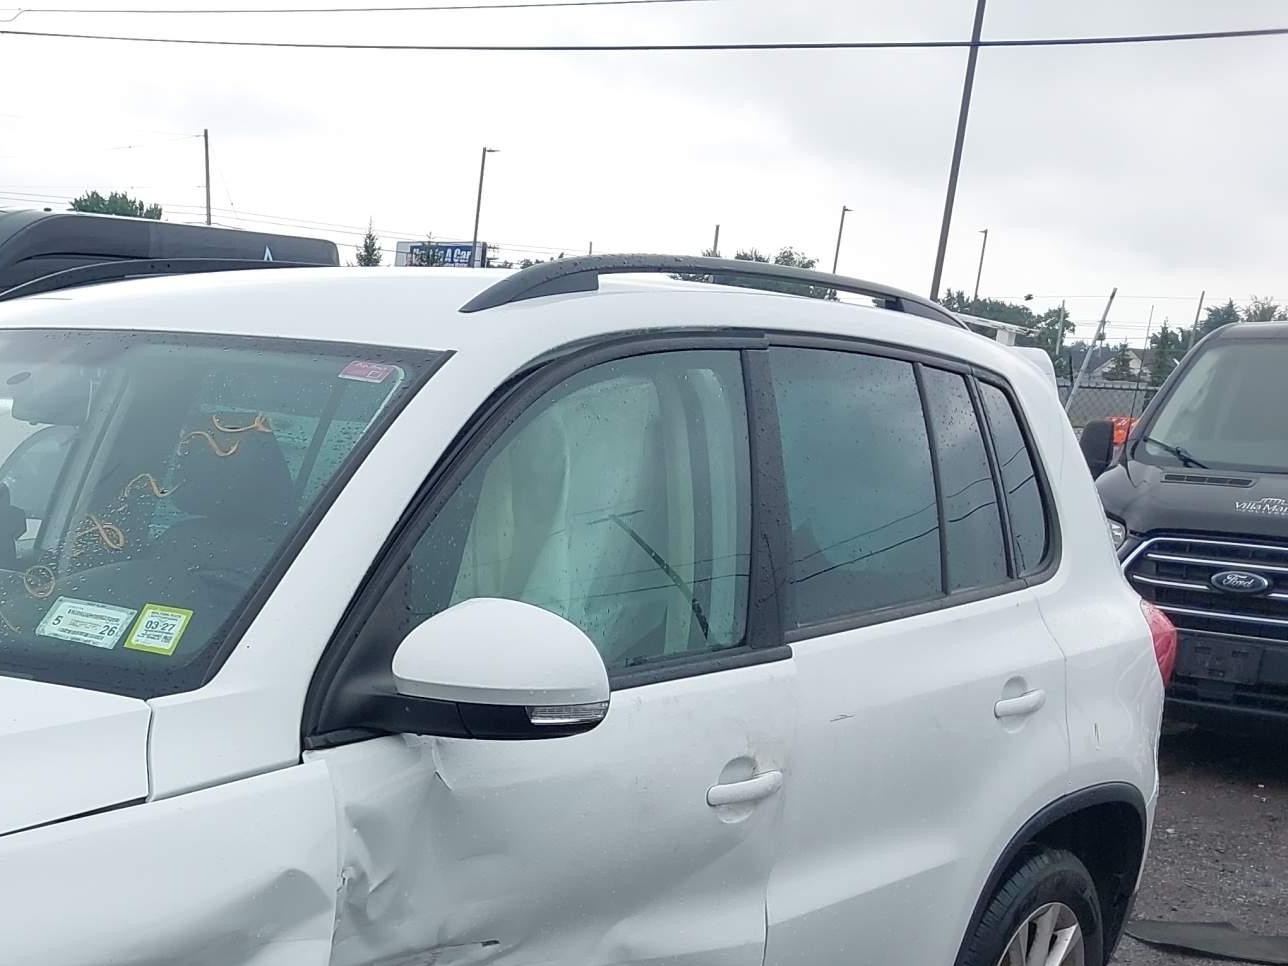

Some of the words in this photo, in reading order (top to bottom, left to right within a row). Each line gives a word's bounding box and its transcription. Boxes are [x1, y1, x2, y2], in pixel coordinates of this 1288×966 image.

[453, 248, 472, 263] Car
[1222, 573, 1255, 589] Ford
[52, 615, 63, 626] 5
[99, 624, 119, 637] 26
